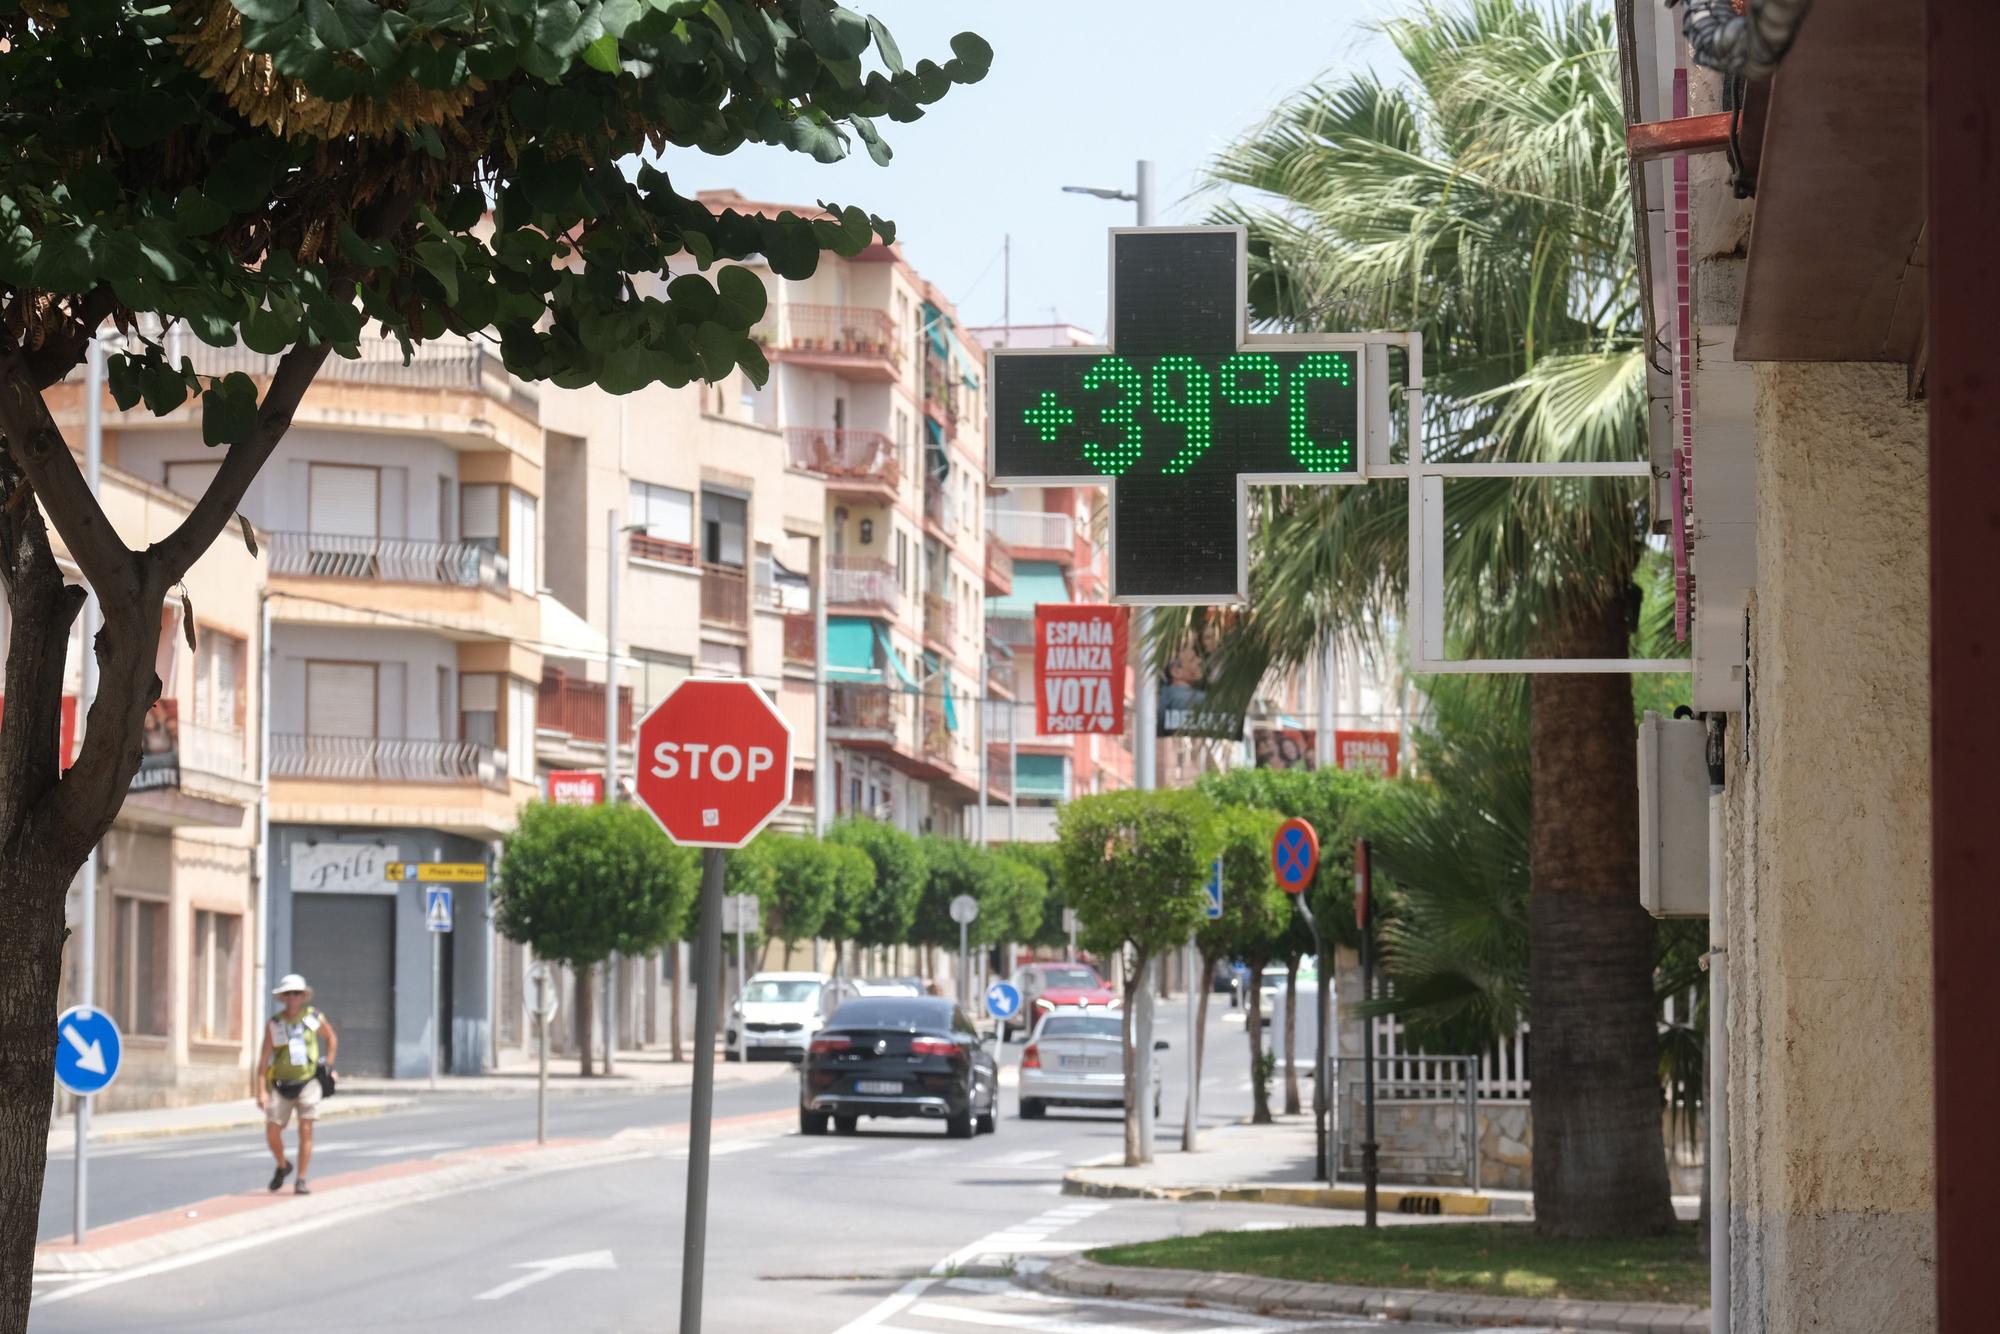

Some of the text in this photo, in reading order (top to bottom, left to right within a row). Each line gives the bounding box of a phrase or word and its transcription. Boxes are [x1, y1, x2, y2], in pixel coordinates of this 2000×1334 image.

[1045, 616, 1113, 645] ESPAÑA
[1045, 646, 1112, 670] AVANZA
[1044, 677, 1113, 714] VOTA
[1046, 715, 1085, 732] PSOE
[651, 741, 774, 782] STOP
